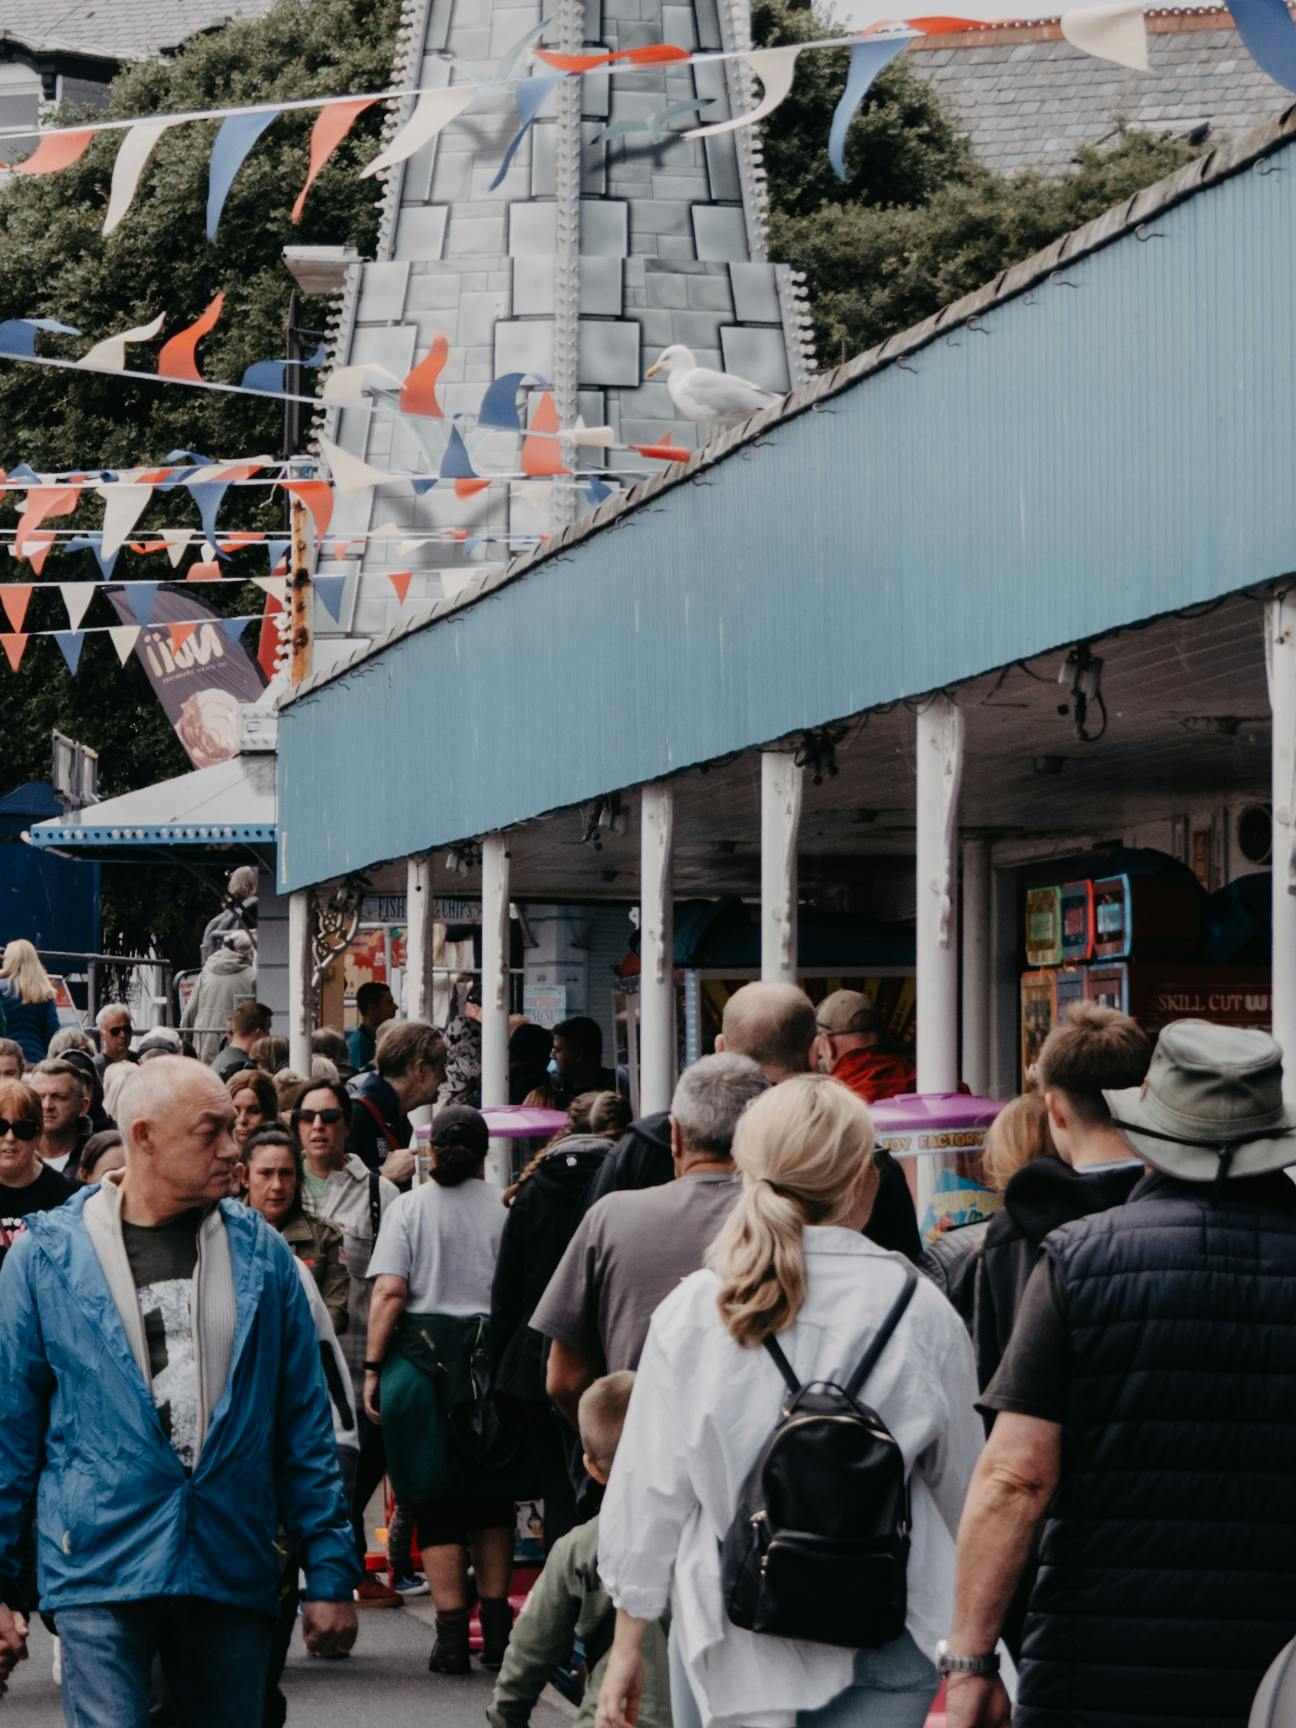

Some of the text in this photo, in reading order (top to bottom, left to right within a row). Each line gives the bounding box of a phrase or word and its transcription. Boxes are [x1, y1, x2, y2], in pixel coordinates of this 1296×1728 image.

[378, 898, 406, 919] FISH
[442, 899, 474, 919] CHIPS
[1158, 994, 1206, 1011] SKILL
[1208, 994, 1243, 1011] CUT
[882, 1132, 985, 1151] TOY FACTORY
